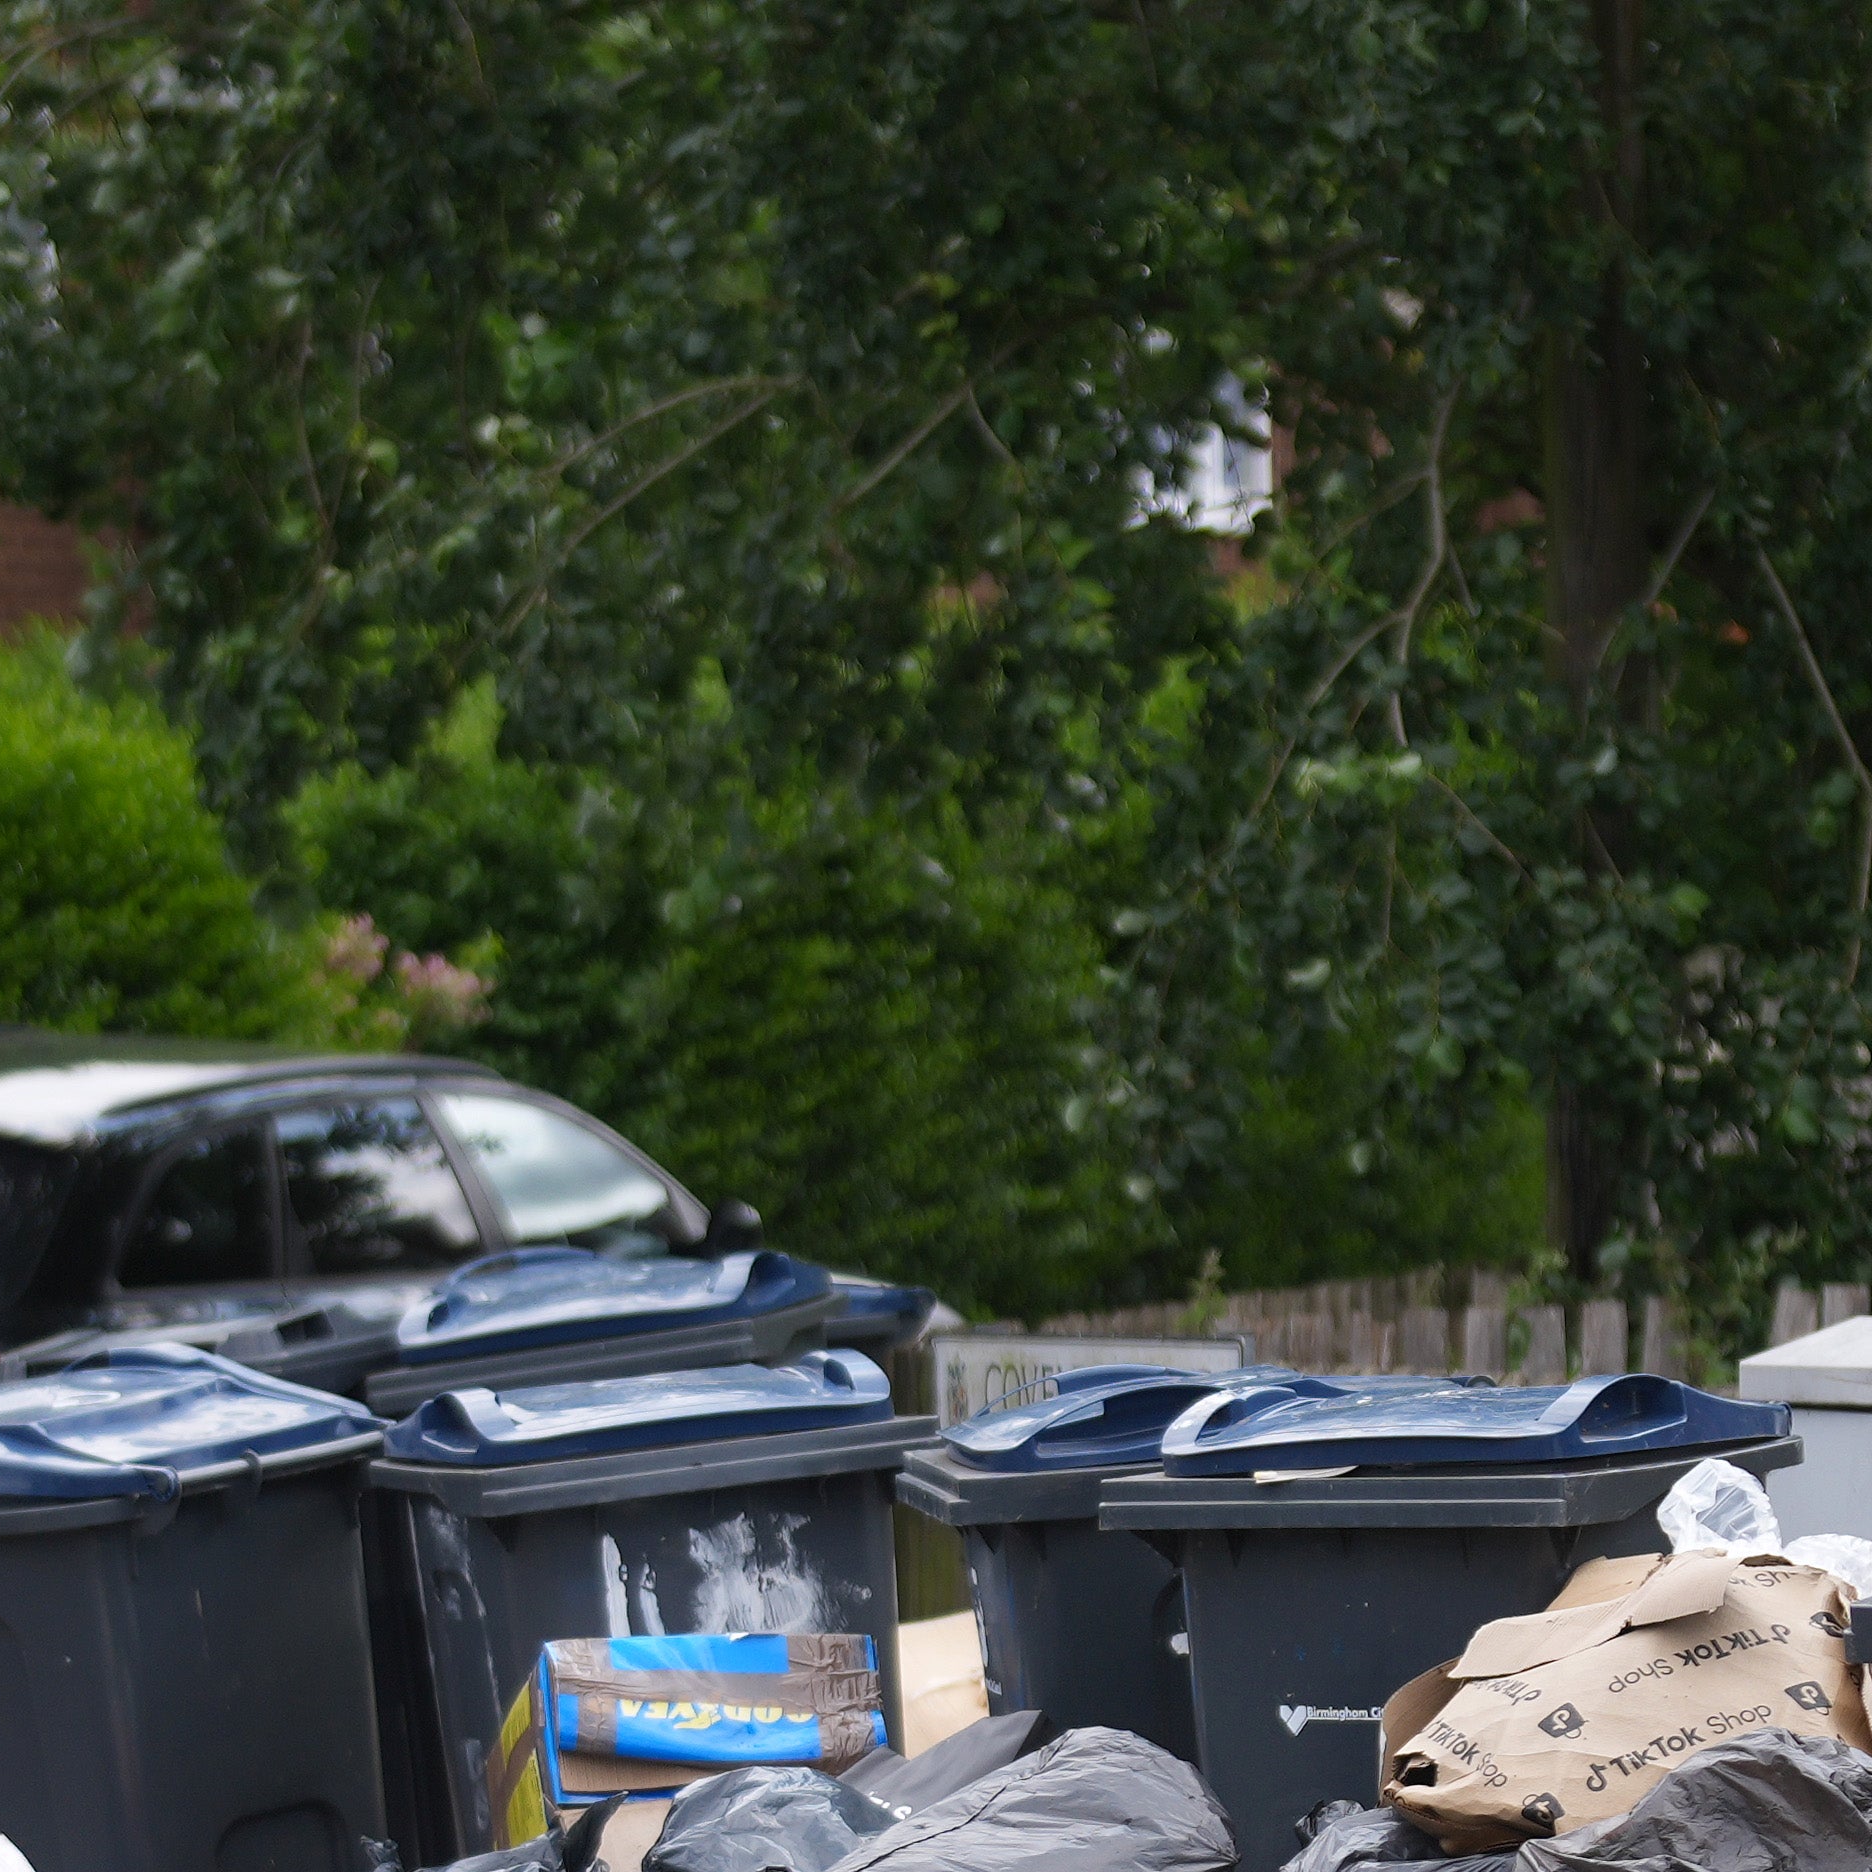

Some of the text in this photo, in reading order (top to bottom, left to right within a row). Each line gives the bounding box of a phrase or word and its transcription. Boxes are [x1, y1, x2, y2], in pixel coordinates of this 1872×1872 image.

[985, 1363, 1063, 1411] COVE
[1754, 1568, 1797, 1588] Sh
[1608, 1628, 1770, 1694] TikTok Shop
[1307, 1705, 1384, 1722] Birmingham Ci
[1427, 1720, 1480, 1766] TikTok
[1609, 1703, 1772, 1776] TikTok Shop
